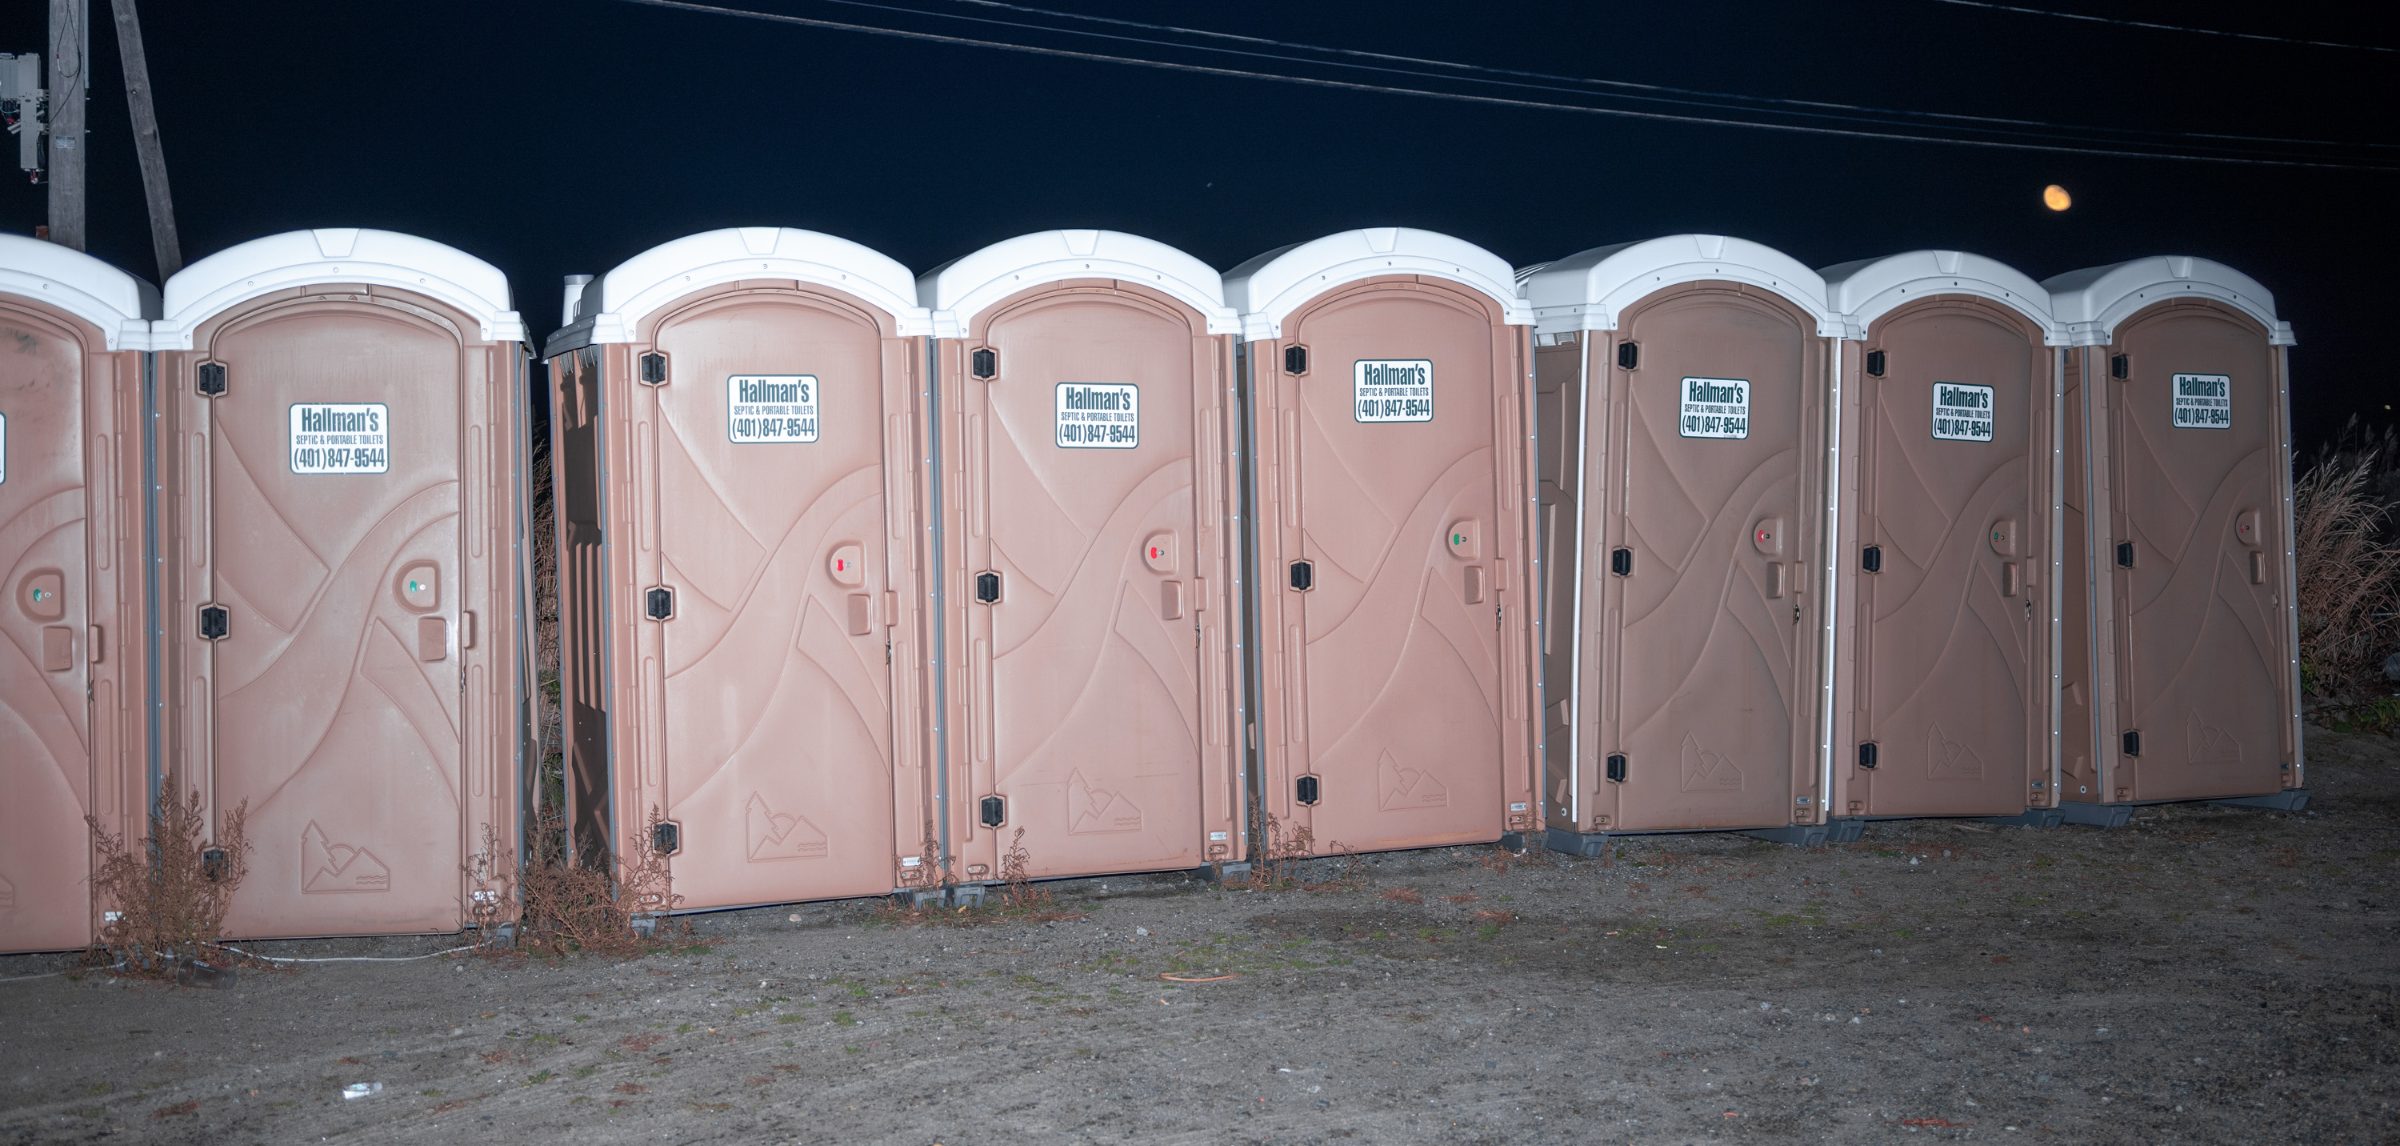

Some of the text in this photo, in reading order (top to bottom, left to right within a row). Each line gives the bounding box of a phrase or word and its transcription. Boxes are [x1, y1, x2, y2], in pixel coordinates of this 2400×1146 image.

[1364, 363, 1426, 386] Hallman's
[739, 379, 810, 403] Hallman's
[1359, 387, 1429, 397] SEPTIC & PORTABLE TOILETS
[1689, 380, 1744, 404] Hallman's
[2179, 376, 2226, 397] Hallman's
[1066, 386, 1131, 411] Hallman's
[1940, 385, 1989, 409] Hallman's
[2176, 398, 2190, 406] SEPTIC
[734, 405, 814, 415] SEPTIC & PORTABLE TOILETS
[1060, 412, 1134, 422] SEPTIC & PORTABLE TOILETS
[1684, 404, 1700, 413] SEPTIC
[1705, 405, 1726, 414] PORTABLE
[1728, 406, 1746, 415] TOILETS
[1936, 408, 1950, 416] SEPTIC
[1954, 408, 1974, 418] PORTABLE
[1974, 410, 1990, 419] TOILETS
[301, 407, 379, 432] Hallman's
[296, 434, 384, 445] SEPTIC & PORTABLE TOILETS
